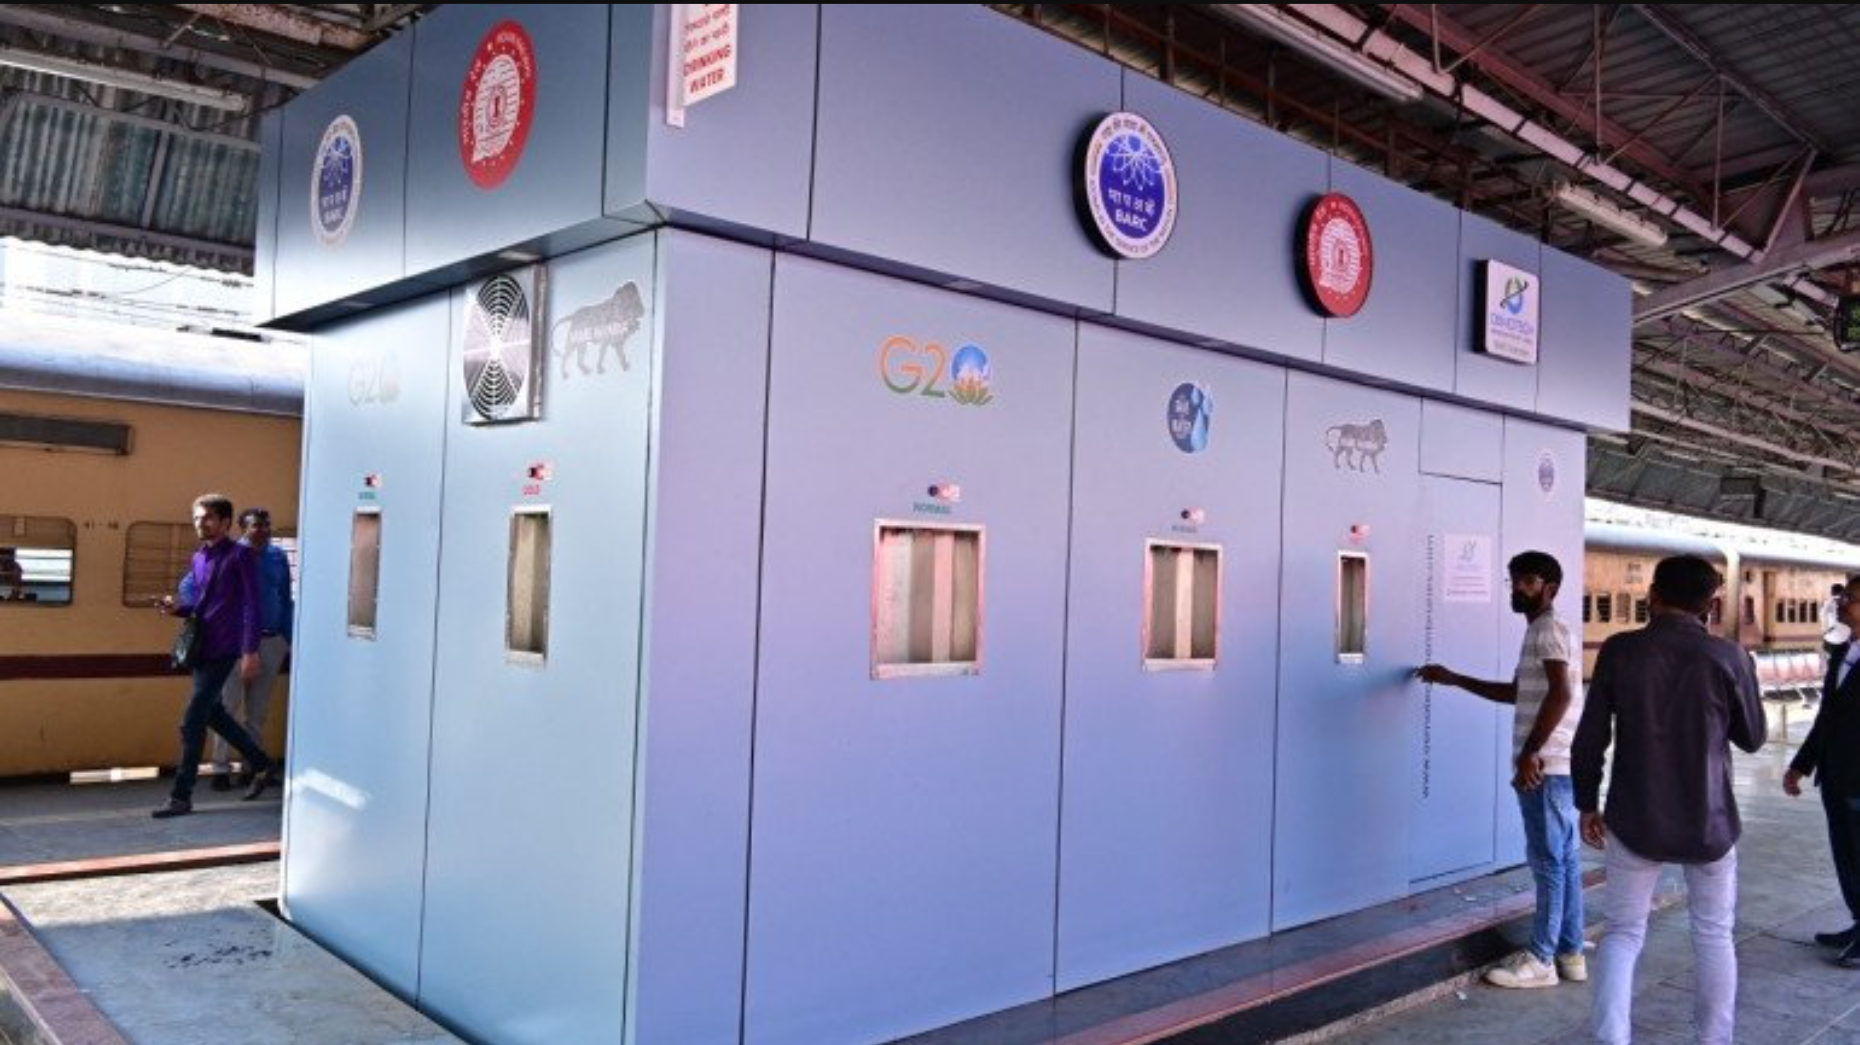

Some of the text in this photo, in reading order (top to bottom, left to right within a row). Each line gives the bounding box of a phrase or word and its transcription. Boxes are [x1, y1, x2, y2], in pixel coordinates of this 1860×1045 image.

[683, 44, 731, 77] DRINKING
[690, 68, 725, 93] WATER
[1115, 208, 1148, 232] BARC
[880, 335, 994, 406] G20
